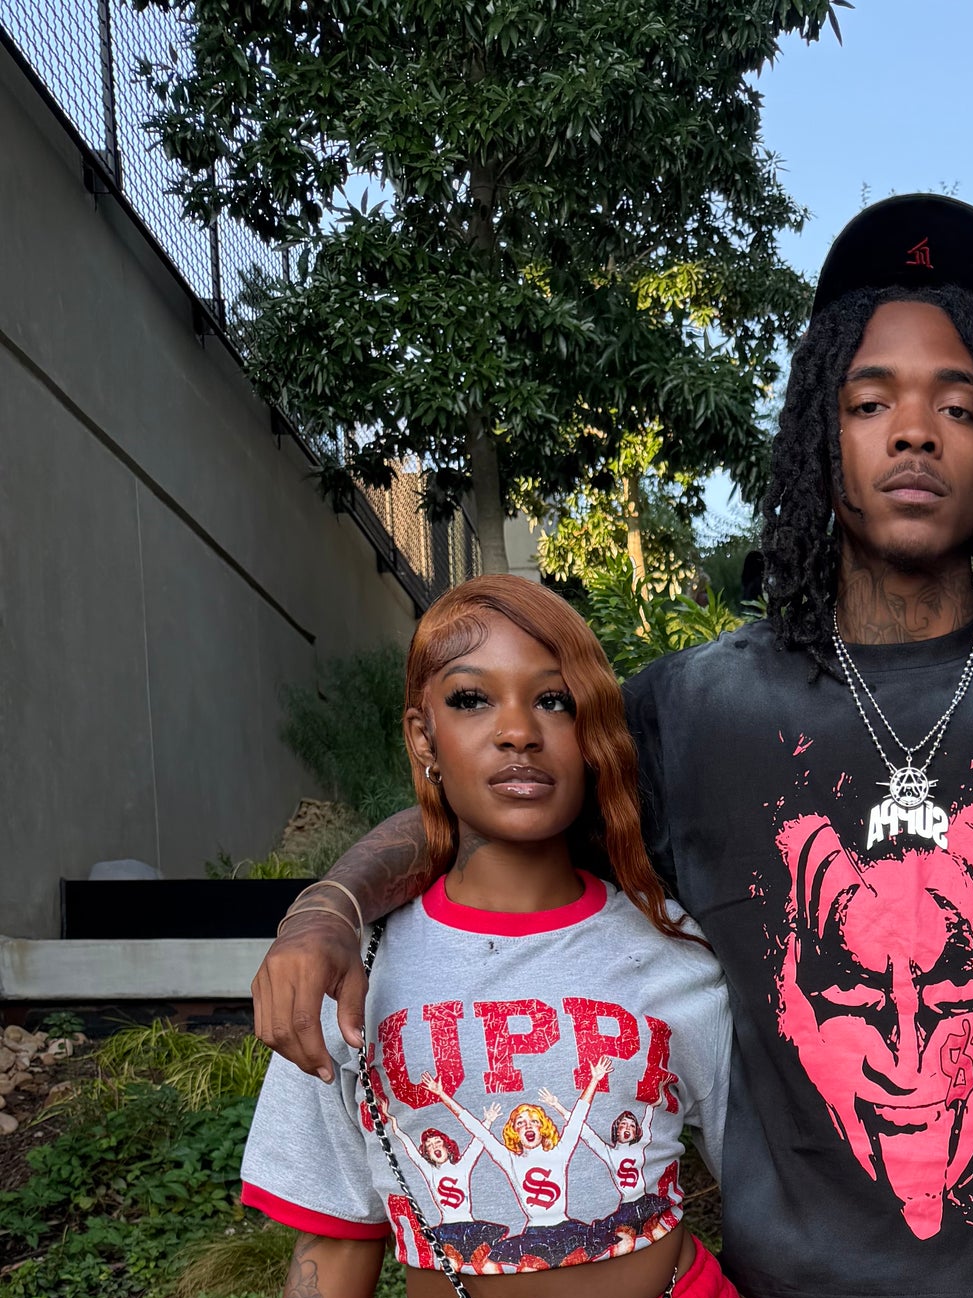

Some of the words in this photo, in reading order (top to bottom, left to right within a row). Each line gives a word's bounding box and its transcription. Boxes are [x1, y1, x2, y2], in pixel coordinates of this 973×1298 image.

[522, 1166, 562, 1210] S
[616, 1158, 639, 1188] S
[437, 1176, 465, 1209] S
